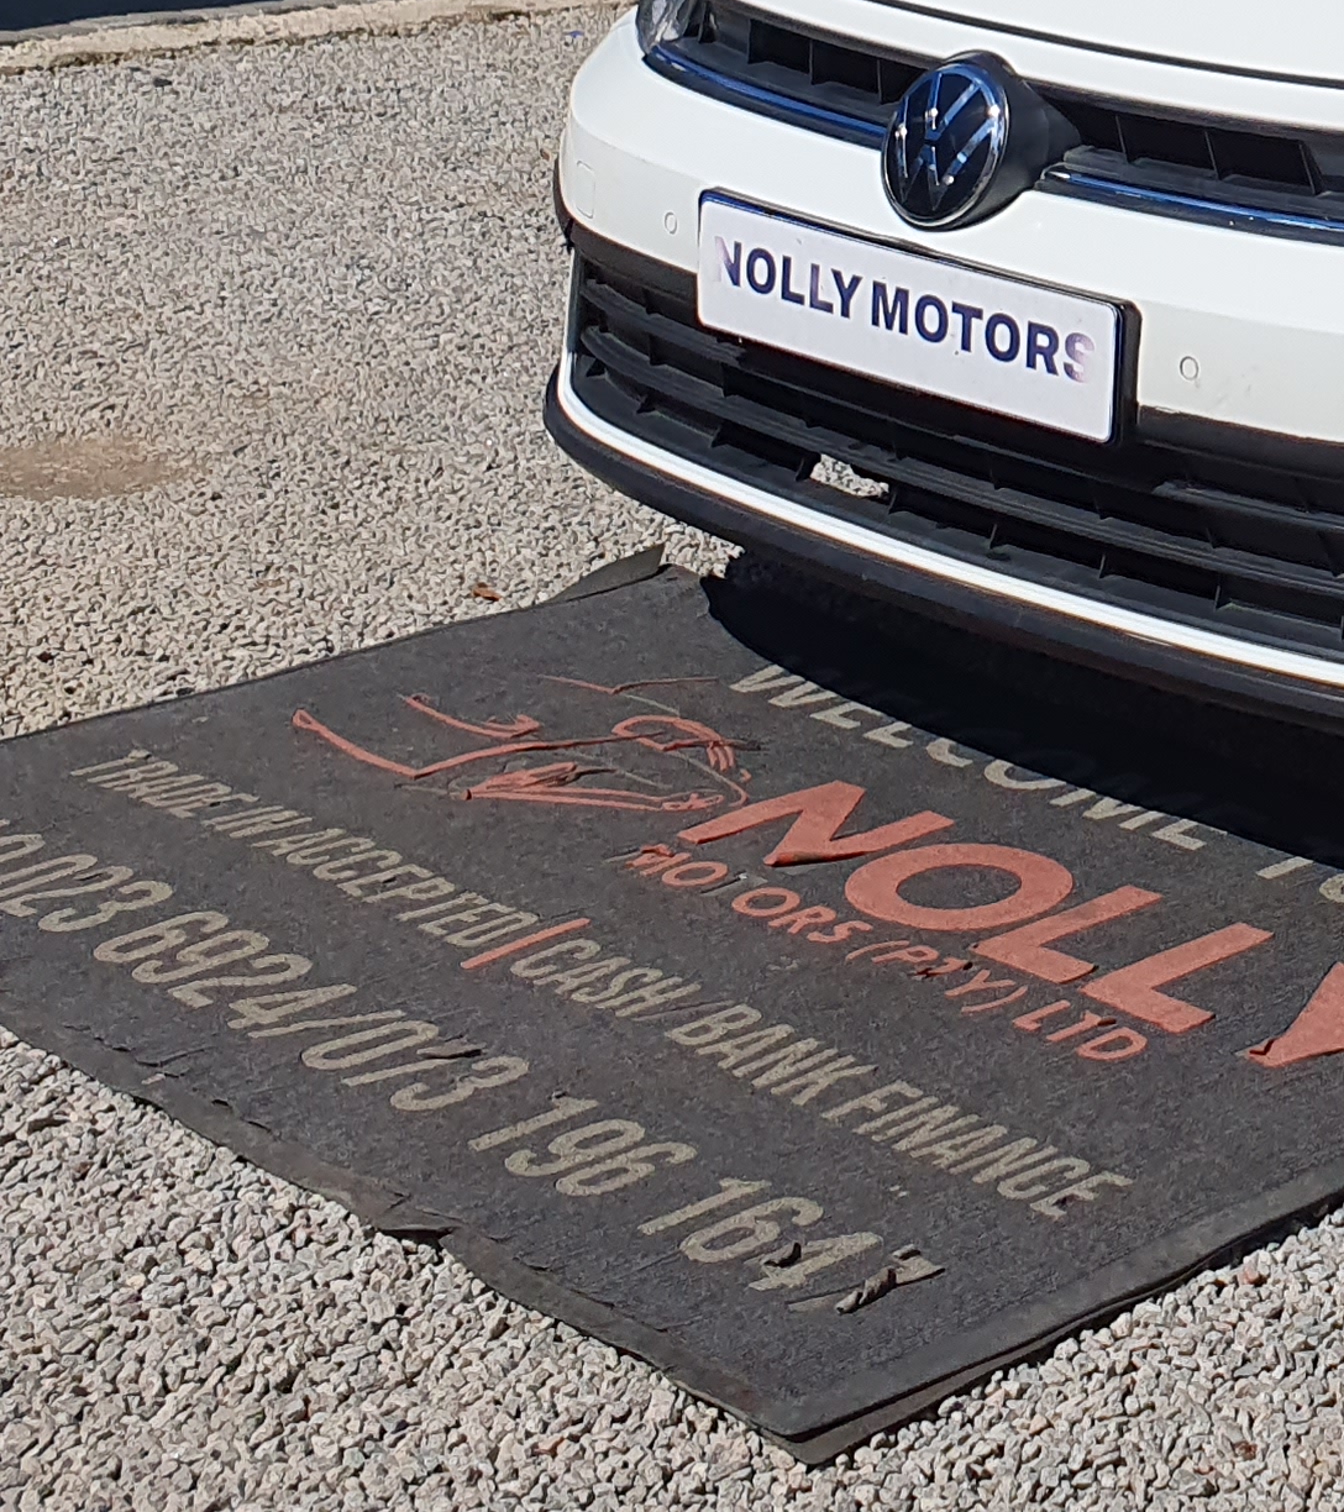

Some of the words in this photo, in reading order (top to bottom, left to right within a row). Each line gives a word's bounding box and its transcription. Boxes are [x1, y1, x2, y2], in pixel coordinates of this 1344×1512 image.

[714, 235, 864, 320] NOLLY
[869, 279, 1097, 384] MOTORS
[70, 749, 260, 819] TRADE
[201, 804, 314, 838] IN
[251, 826, 540, 949] ACCEPTED
[1011, 998, 1149, 1062] LTD
[467, 1091, 698, 1198] 196
[820, 1079, 1134, 1220] FINANCE
